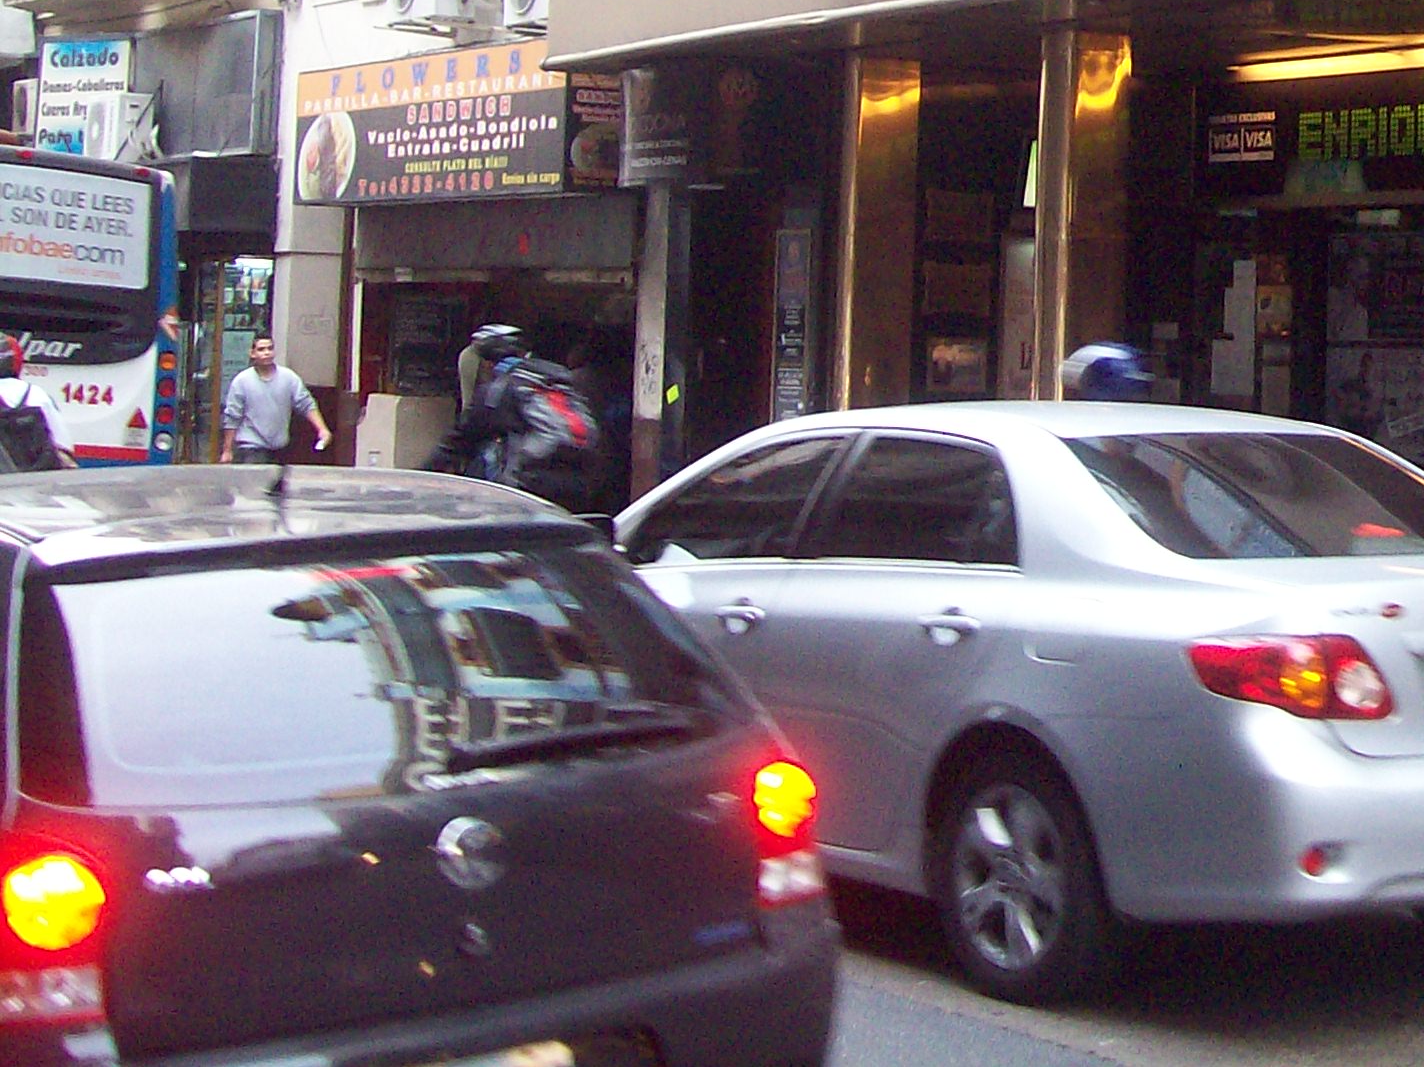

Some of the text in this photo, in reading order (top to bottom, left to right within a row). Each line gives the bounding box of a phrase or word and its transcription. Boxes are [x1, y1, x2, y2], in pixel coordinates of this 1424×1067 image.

[50, 47, 119, 68] Calzado
[331, 49, 522, 96] FLOWERS
[41, 100, 88, 121] Cueros Arg
[406, 94, 512, 125] SANDWICH
[1212, 130, 1273, 151] VISA VISA
[51, 188, 87, 209] QUE
[91, 193, 135, 215] LEES
[11, 206, 49, 227] SON
[55, 211, 79, 231] DE
[19, 331, 83, 362] lpar
[62, 382, 114, 406] 1424
